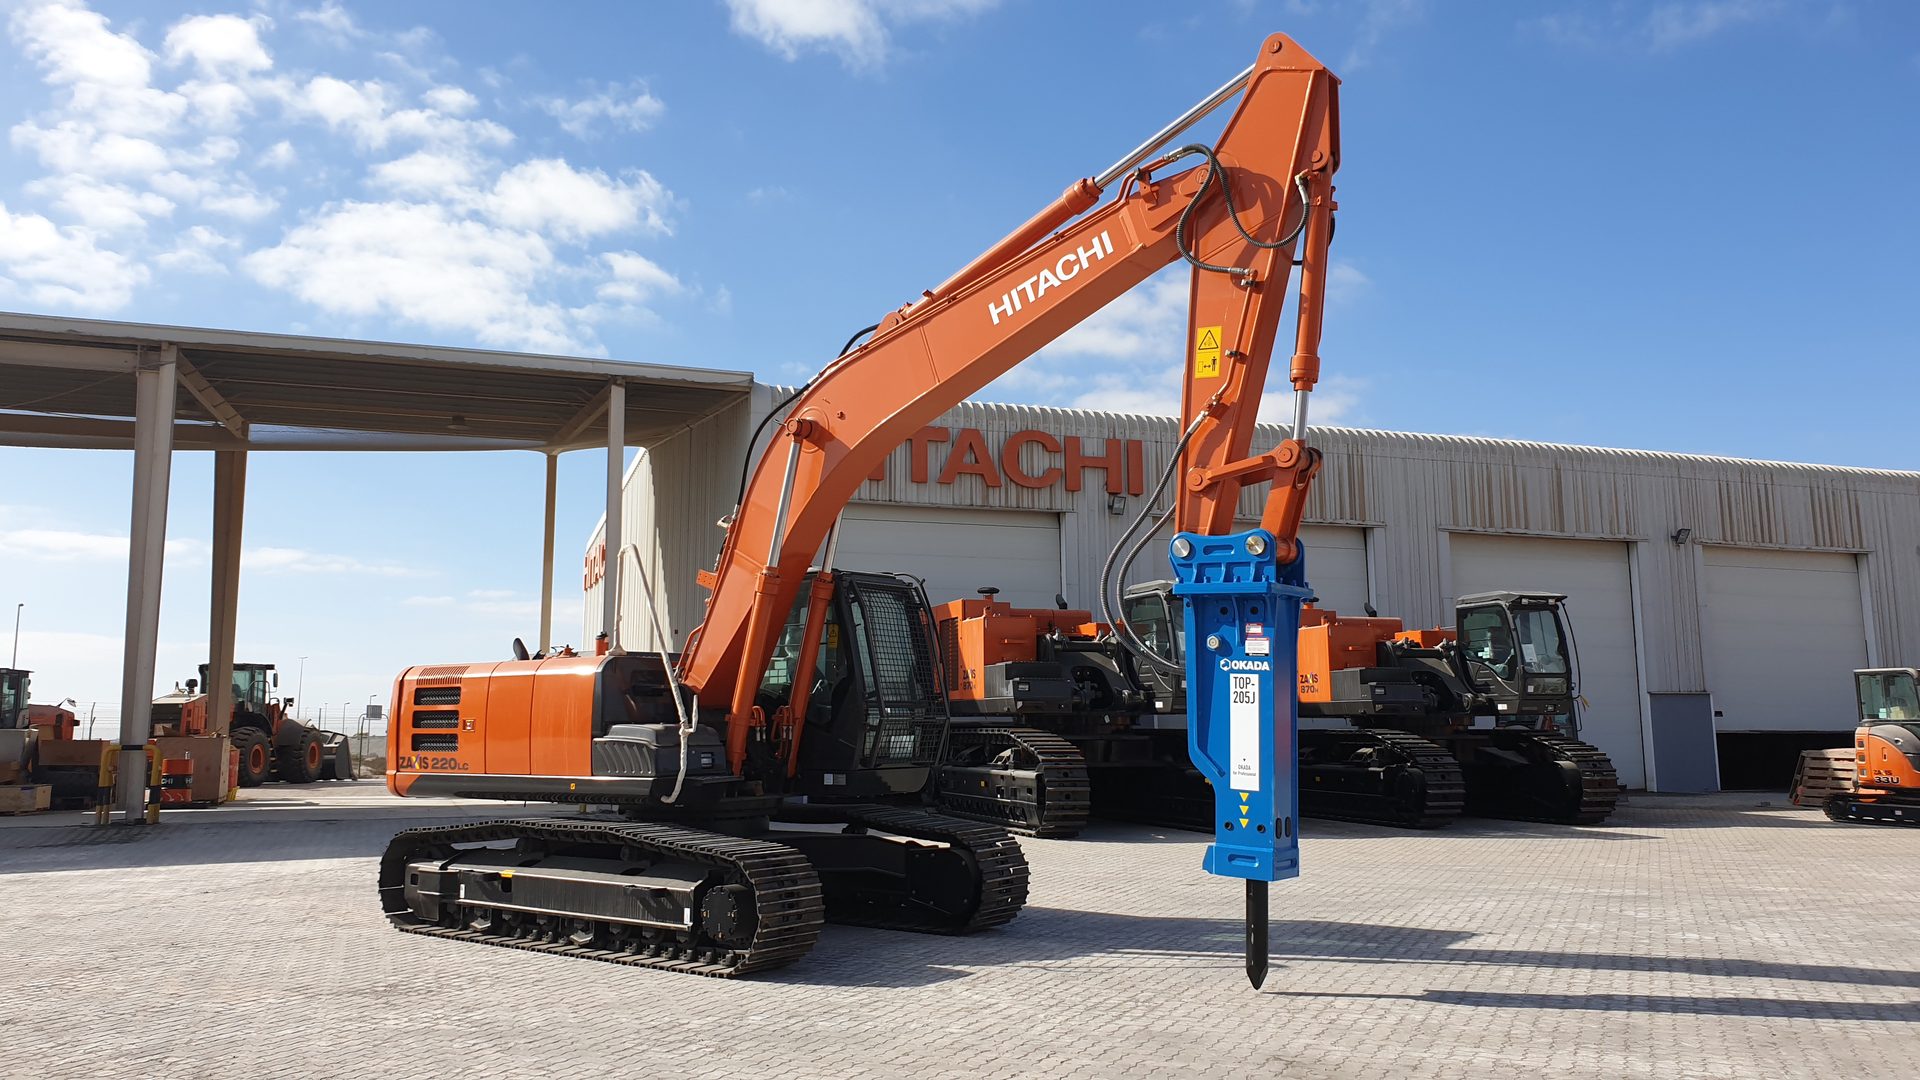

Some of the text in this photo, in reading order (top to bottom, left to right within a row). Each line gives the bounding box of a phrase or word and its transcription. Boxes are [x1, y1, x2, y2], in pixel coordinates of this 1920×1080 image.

[988, 230, 1114, 325] HITACHI
[867, 426, 1144, 496] TACHI
[584, 541, 606, 592] HITAC
[1231, 660, 1270, 671] OKADA
[1233, 676, 1255, 690] TOP-
[1233, 691, 1255, 704] 205J
[400, 754, 429, 769] ZAXIS
[1874, 776, 1900, 784] 33U
